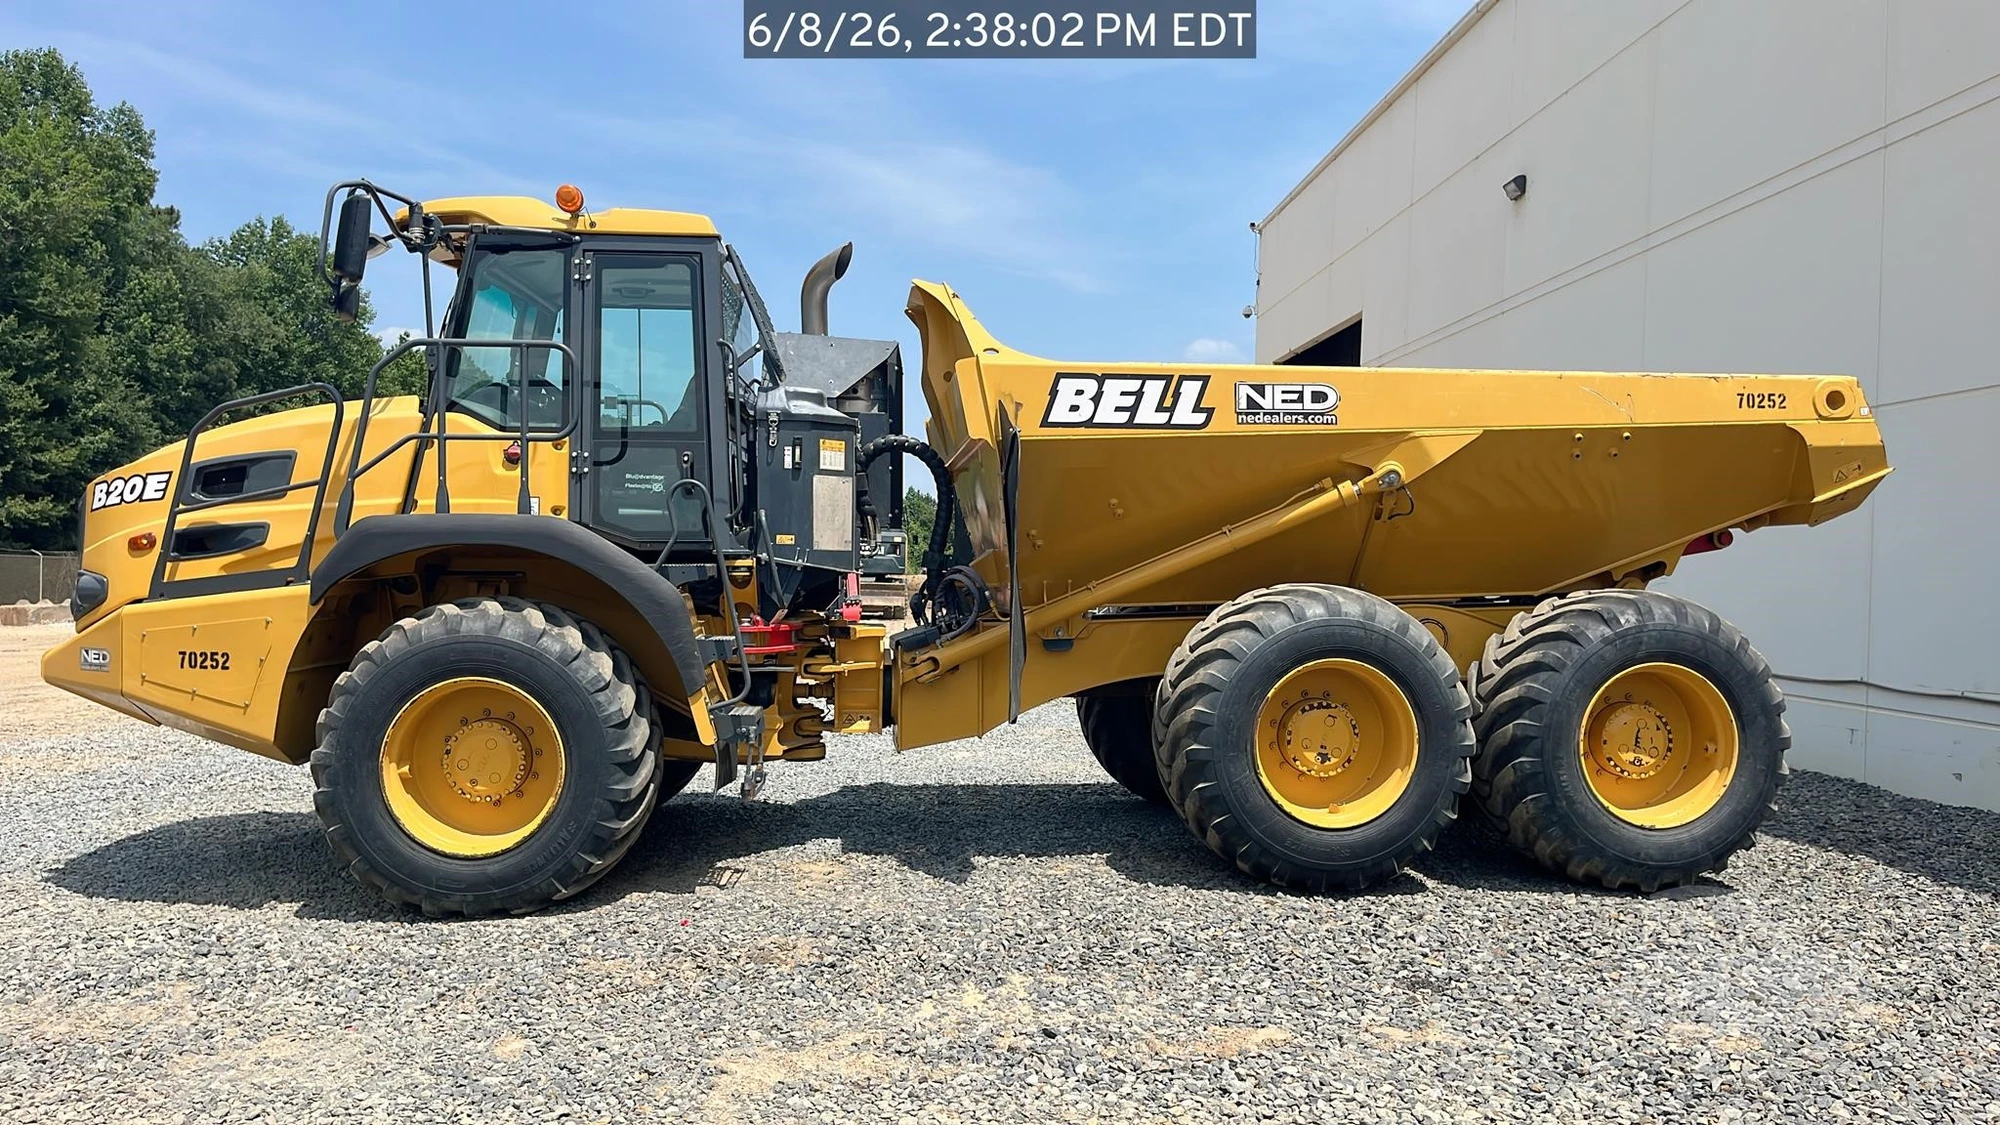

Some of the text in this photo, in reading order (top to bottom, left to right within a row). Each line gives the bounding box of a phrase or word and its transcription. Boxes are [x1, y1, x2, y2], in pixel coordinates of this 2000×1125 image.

[1043, 374, 1212, 427] BELL
[1236, 383, 1339, 410] NED
[1736, 392, 1787, 410] 70252
[1237, 411, 1337, 424] nedealers.com
[91, 472, 172, 511] B20E
[81, 648, 110, 664] NED
[178, 650, 230, 671] 70252
